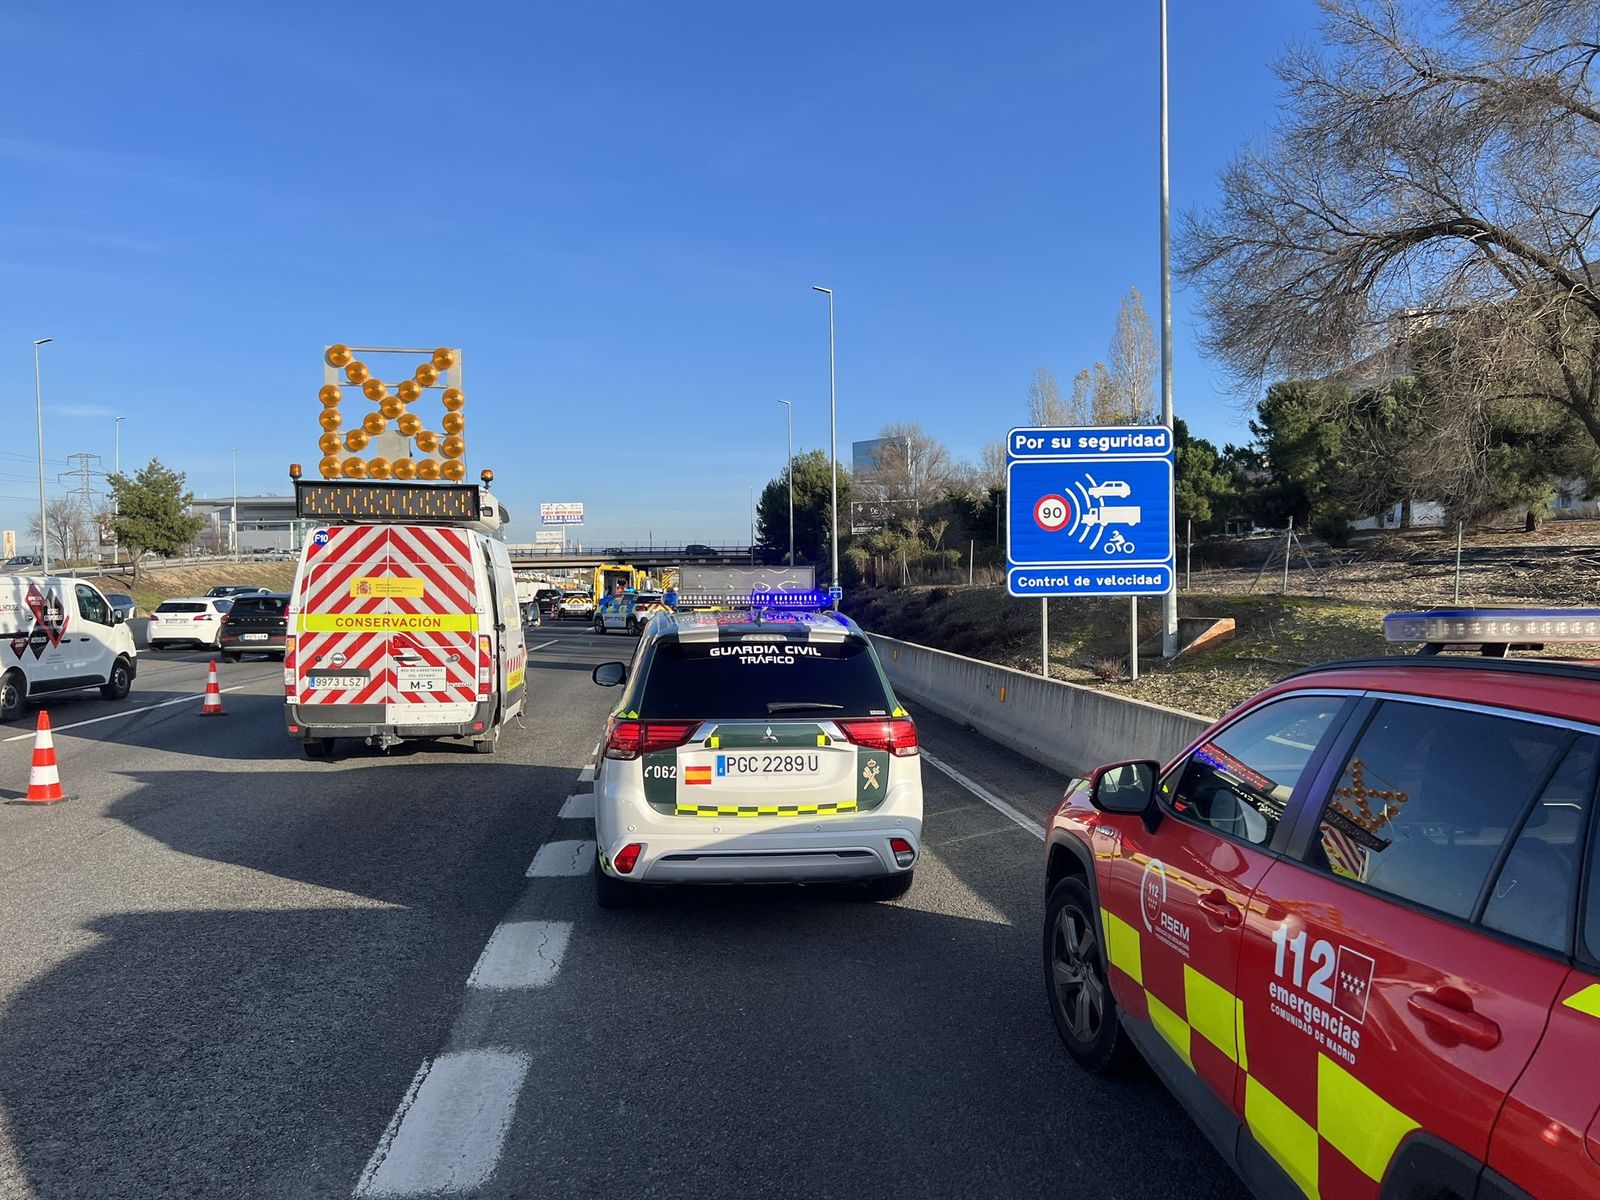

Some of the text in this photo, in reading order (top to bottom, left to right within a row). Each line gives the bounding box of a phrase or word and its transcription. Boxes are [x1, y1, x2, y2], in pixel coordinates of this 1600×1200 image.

[1015, 434, 1165, 451] Por su seguridad
[1042, 507, 1062, 519] 90
[314, 533, 329, 544] F10
[1017, 574, 1162, 588] Control de velocidad
[335, 616, 441, 628] CONSERVACIÓN
[709, 645, 821, 657] GUARDIA CIVIL
[739, 655, 794, 665] TRÁFICO
[316, 677, 361, 687] 9973 LSZ
[410, 681, 433, 690] M-5
[726, 755, 819, 773] PGC 2289 U
[653, 766, 677, 779] 062
[1148, 881, 1159, 898] 112
[1272, 922, 1336, 1004] 112
[1269, 982, 1360, 1049] emergencias
[1270, 1002, 1356, 1065] COMUNIDAD DE MADRID
